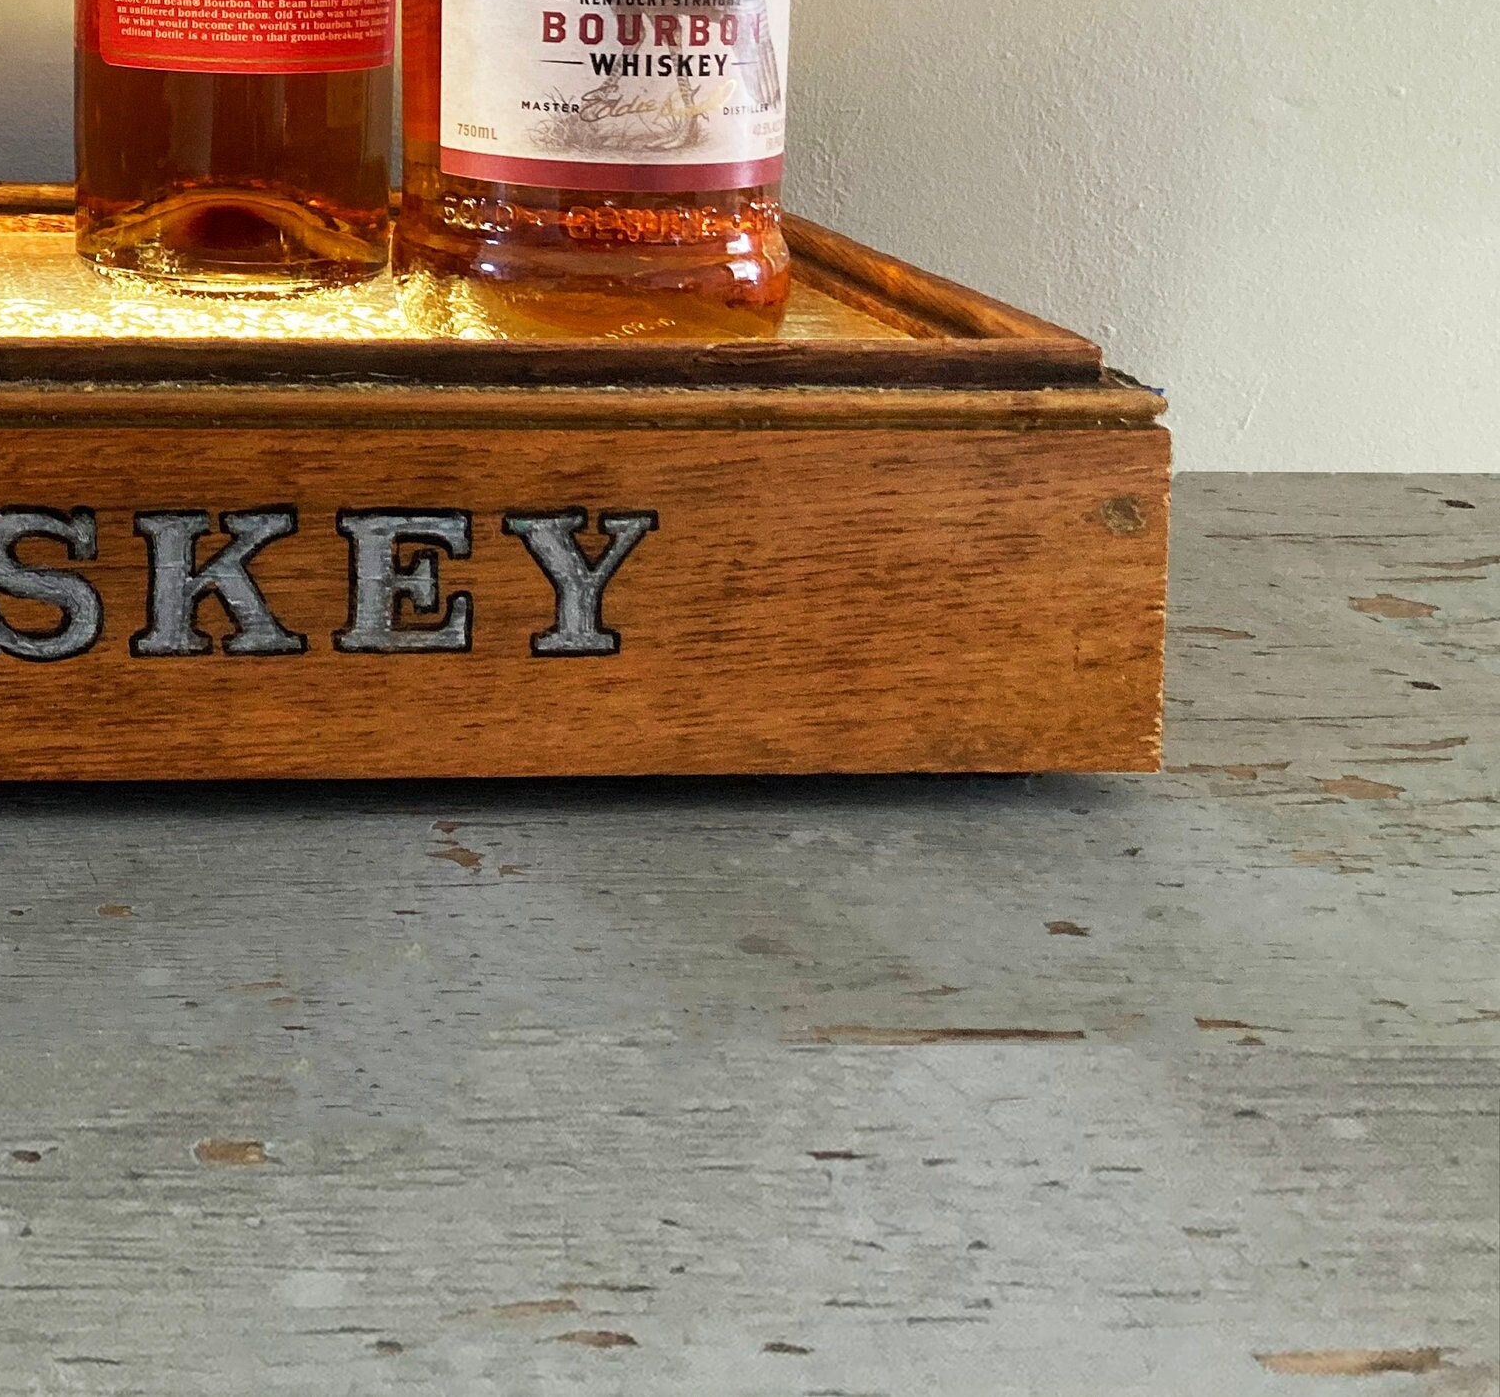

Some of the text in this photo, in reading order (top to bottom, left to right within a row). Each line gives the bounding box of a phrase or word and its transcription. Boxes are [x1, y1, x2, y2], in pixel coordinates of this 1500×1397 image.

[279, 0, 307, 8] Beam
[129, 6, 175, 17] unfiltered
[178, 8, 218, 19] bonded
[275, 10, 293, 19] Old
[327, 10, 344, 18] was
[133, 17, 154, 26] what
[158, 19, 188, 29] would
[192, 20, 235, 31] become
[238, 21, 255, 31] the
[260, 21, 297, 31] world's
[121, 26, 152, 38] edition
[155, 28, 184, 40] bottle
[188, 30, 198, 40] is
[211, 31, 249, 42] tribute
[252, 32, 263, 41] to
[266, 31, 288, 42] that
[590, 53, 728, 77] WHISKEY
[521, 101, 580, 115] MASTER
[457, 123, 499, 141] 750mL
